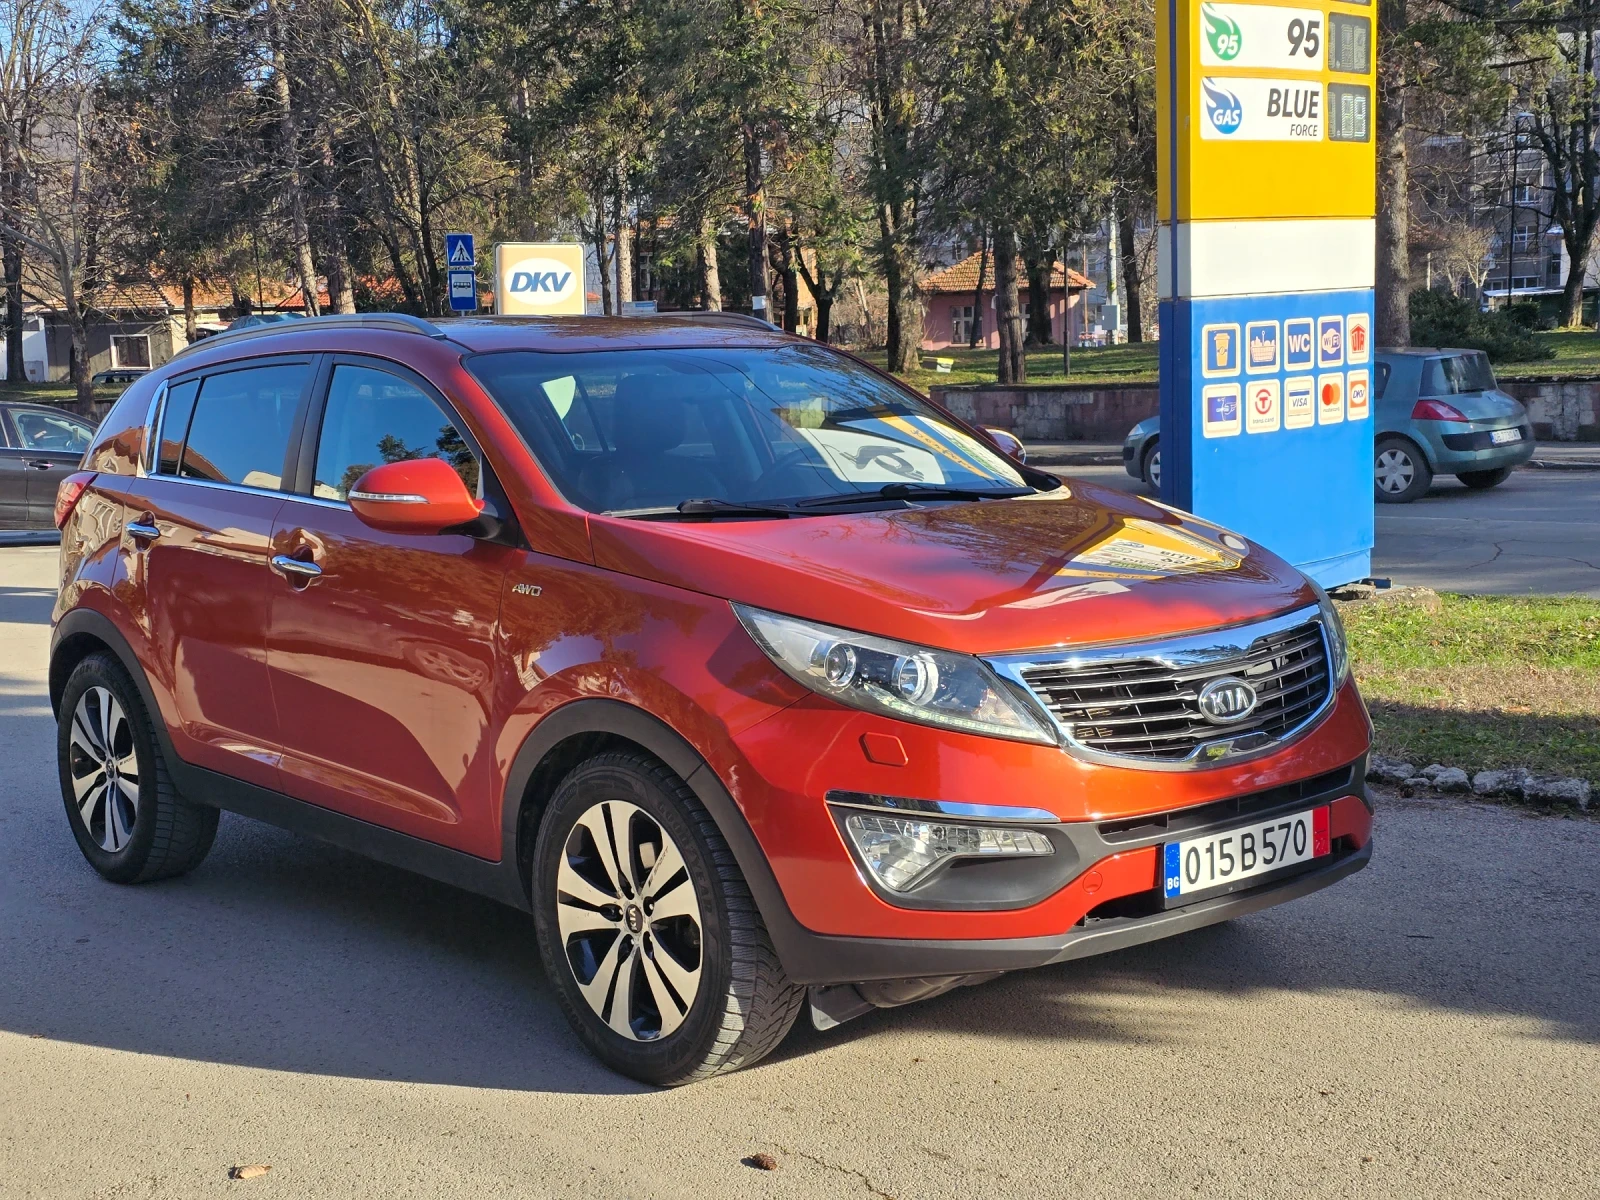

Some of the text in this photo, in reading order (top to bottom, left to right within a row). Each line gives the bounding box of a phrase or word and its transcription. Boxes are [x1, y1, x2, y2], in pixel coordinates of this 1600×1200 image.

[1217, 34, 1239, 55] 95
[1287, 18, 1320, 58] 95
[1267, 88, 1320, 119] BLUE
[1213, 109, 1241, 126] GAS
[1290, 123, 1318, 137] FORCE
[509, 271, 571, 293] DKV
[1288, 333, 1311, 353] WC
[1292, 396, 1308, 408] VISA
[1352, 389, 1365, 399] DKV
[512, 583, 542, 597] AWD
[1209, 687, 1250, 715] KIA
[1185, 819, 1307, 885] 015B570
[1166, 876, 1180, 890] BG
